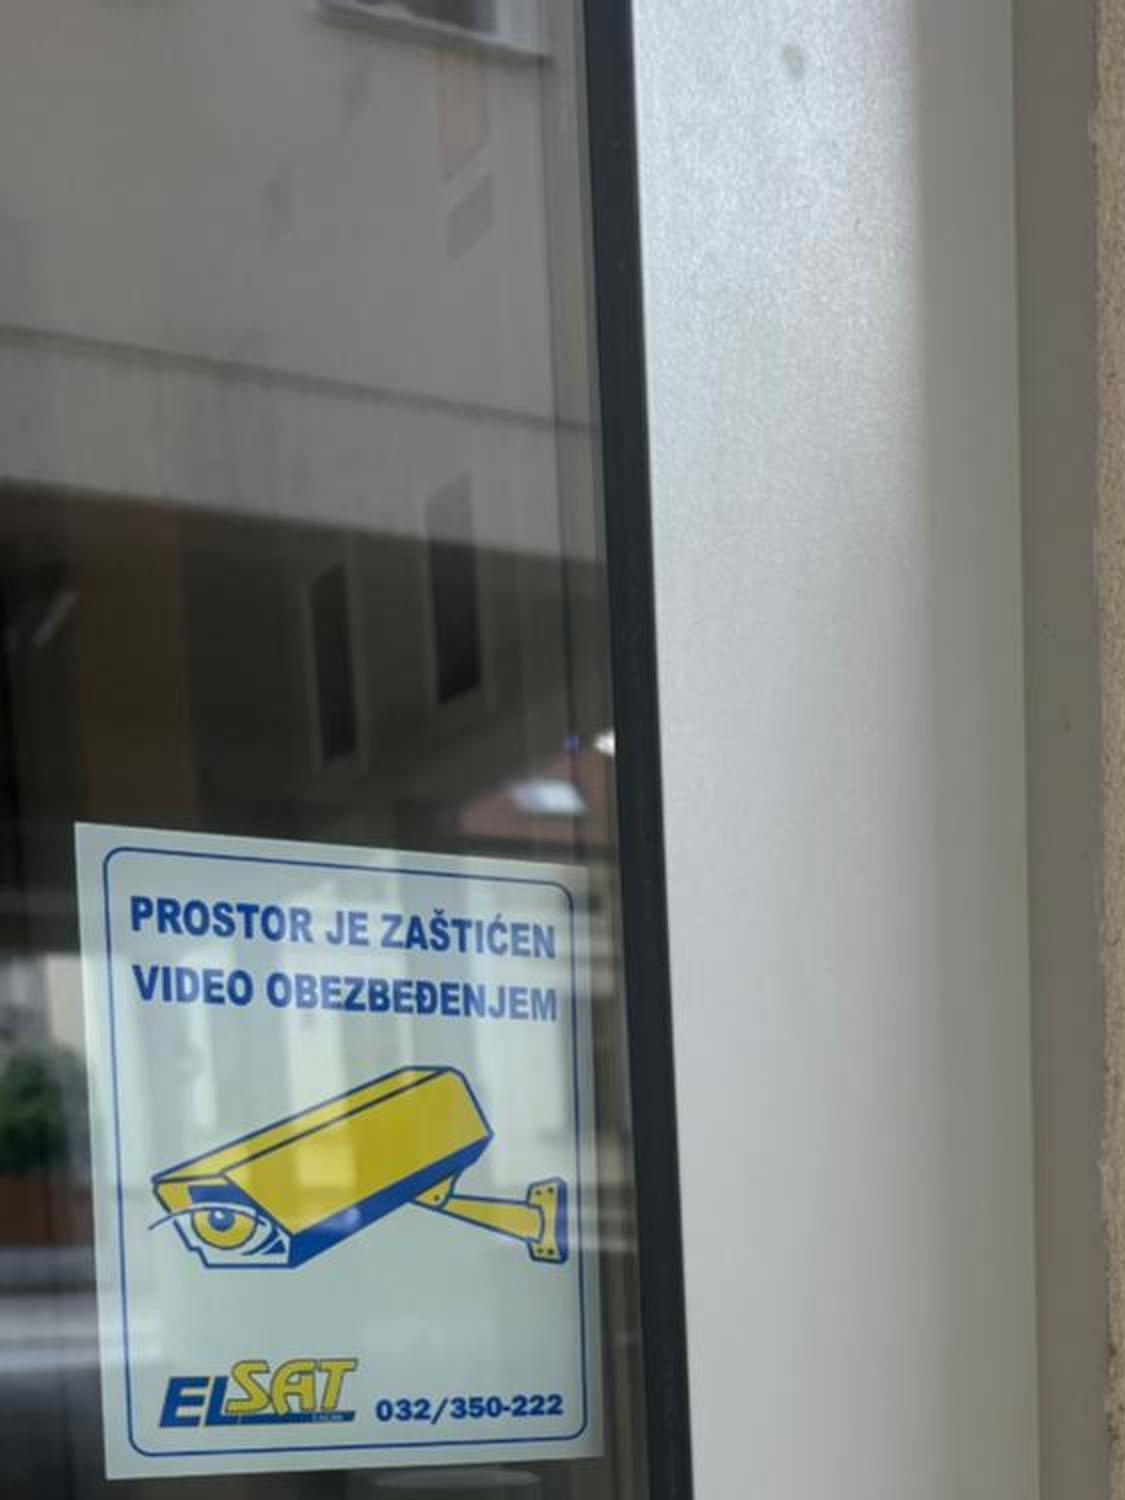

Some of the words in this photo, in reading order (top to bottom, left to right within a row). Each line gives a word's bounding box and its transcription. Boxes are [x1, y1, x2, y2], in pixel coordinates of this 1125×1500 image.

[130, 895, 313, 943] PROSTOR
[325, 910, 369, 947] JE
[381, 907, 556, 959] ZAŠTIĆEN
[132, 964, 254, 1006] VIDEO
[266, 971, 557, 1021] OBEZBEĐENJEM
[159, 1357, 359, 1428] ELSAT
[375, 1394, 564, 1425] 032/350-222
